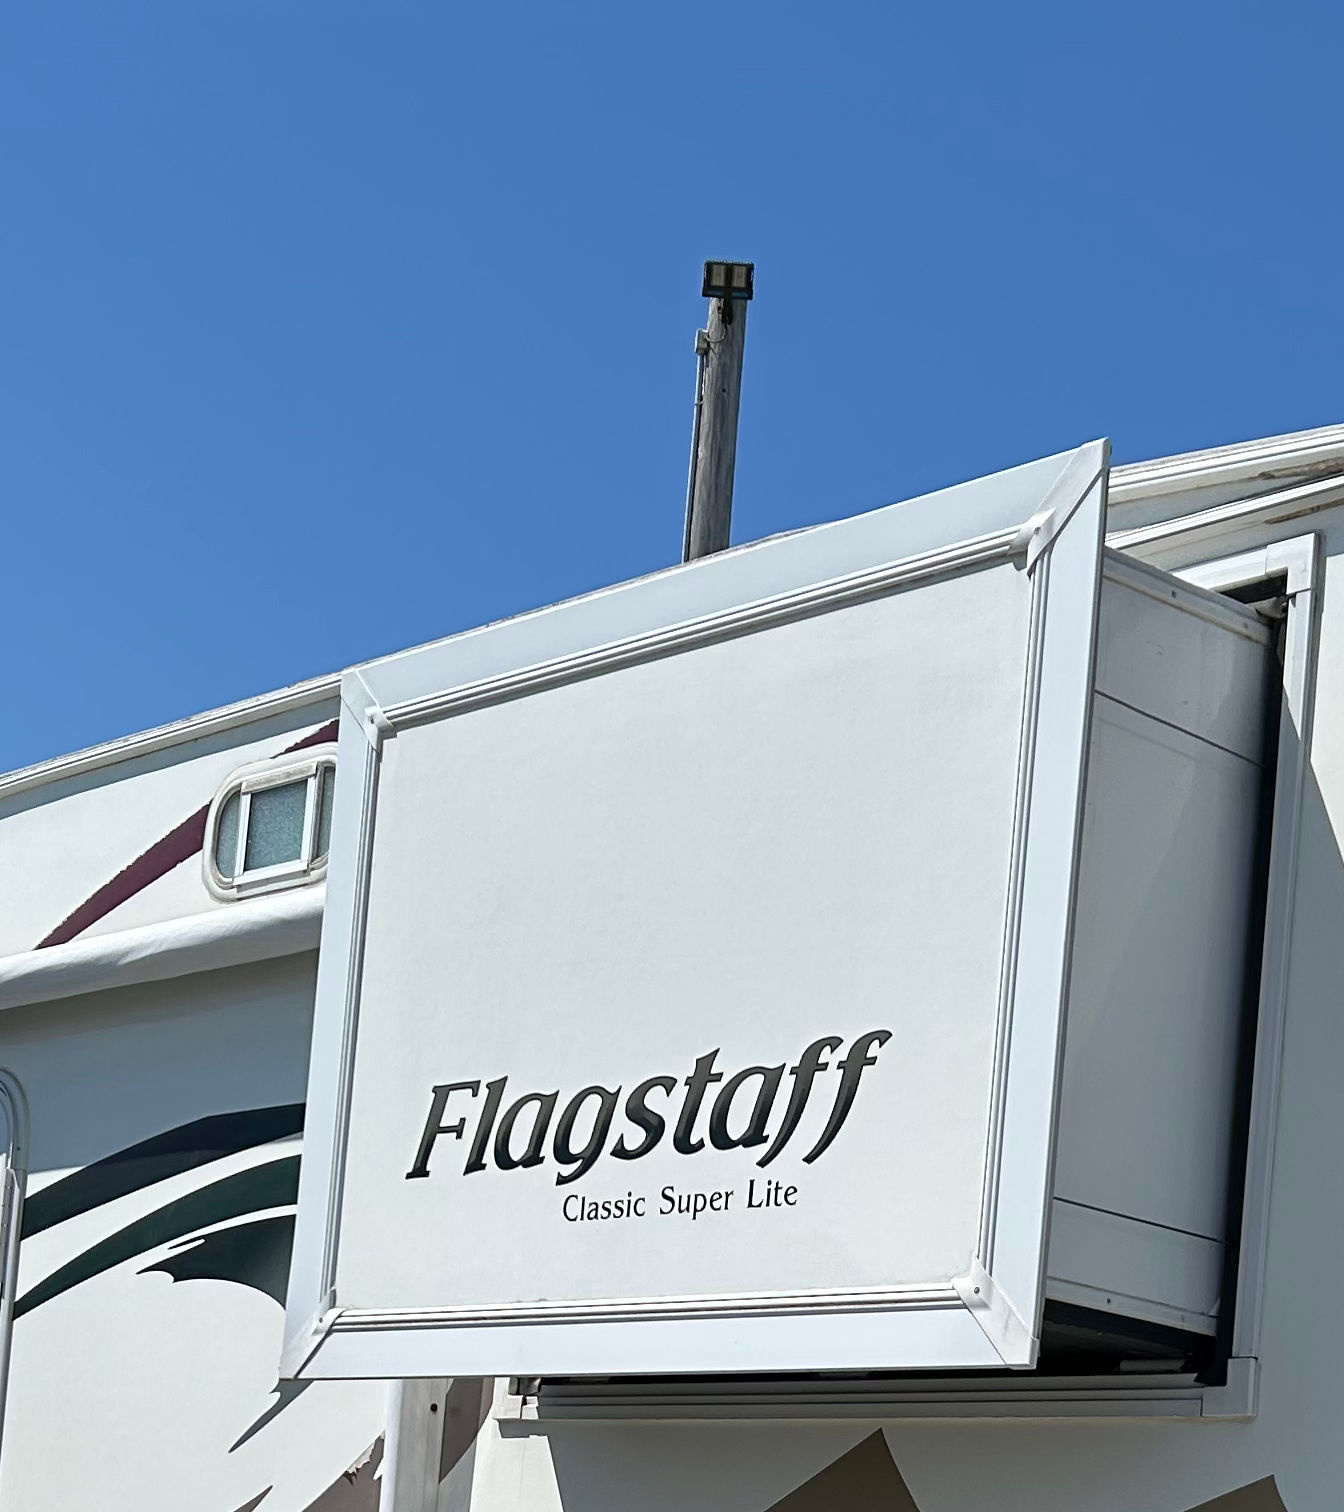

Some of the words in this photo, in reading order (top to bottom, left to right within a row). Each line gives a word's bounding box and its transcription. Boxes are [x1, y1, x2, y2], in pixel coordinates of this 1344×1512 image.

[405, 1028, 894, 1187] Flagstaff
[562, 1190, 646, 1222] Classic
[659, 1185, 735, 1220] Super
[746, 1178, 799, 1209] Lite
